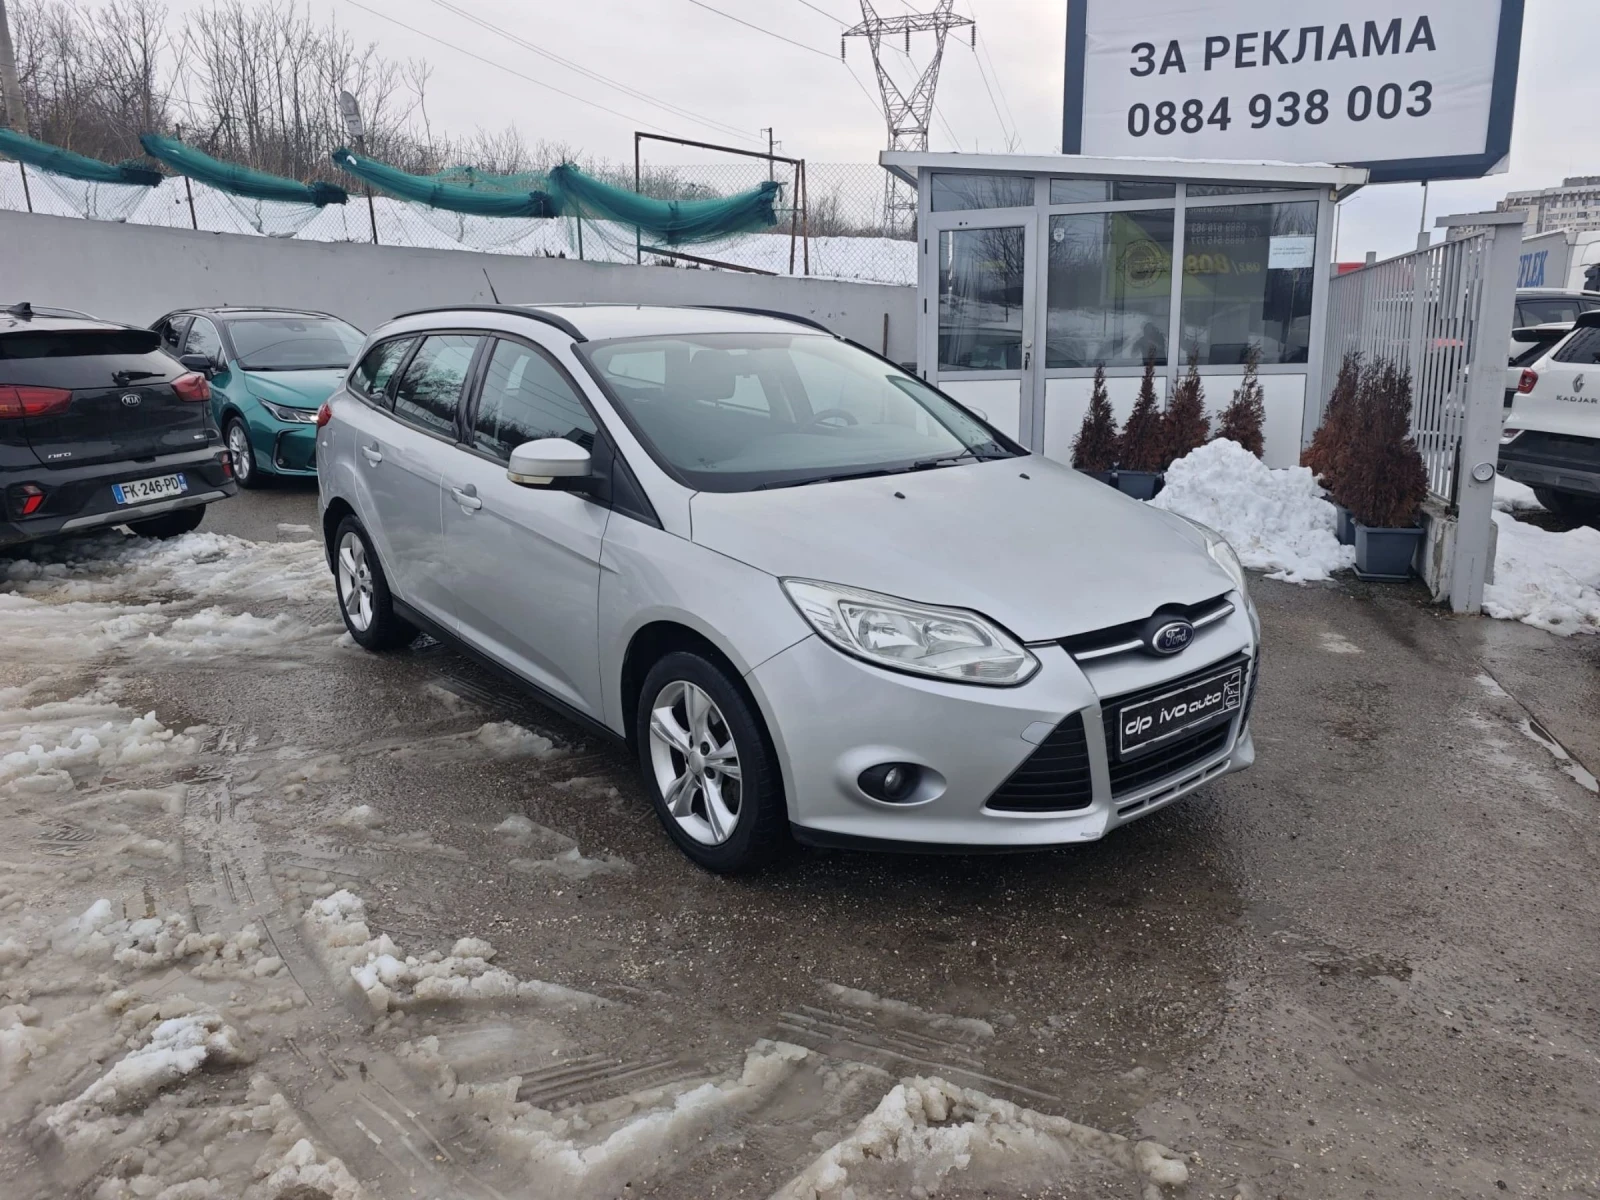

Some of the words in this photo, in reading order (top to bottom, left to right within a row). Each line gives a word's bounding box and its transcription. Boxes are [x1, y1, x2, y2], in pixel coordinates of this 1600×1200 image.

[1129, 39, 1187, 77] ЗА
[1204, 15, 1437, 72] РЕКЛАМА
[1127, 96, 1232, 138] 0884
[1248, 88, 1330, 130] 938
[1347, 79, 1433, 122] 003
[1556, 394, 1598, 404] KADJAR
[1165, 627, 1187, 647] Ford
[1125, 716, 1152, 734] dp
[1159, 703, 1187, 724] ivo
[1188, 691, 1222, 713] auto
